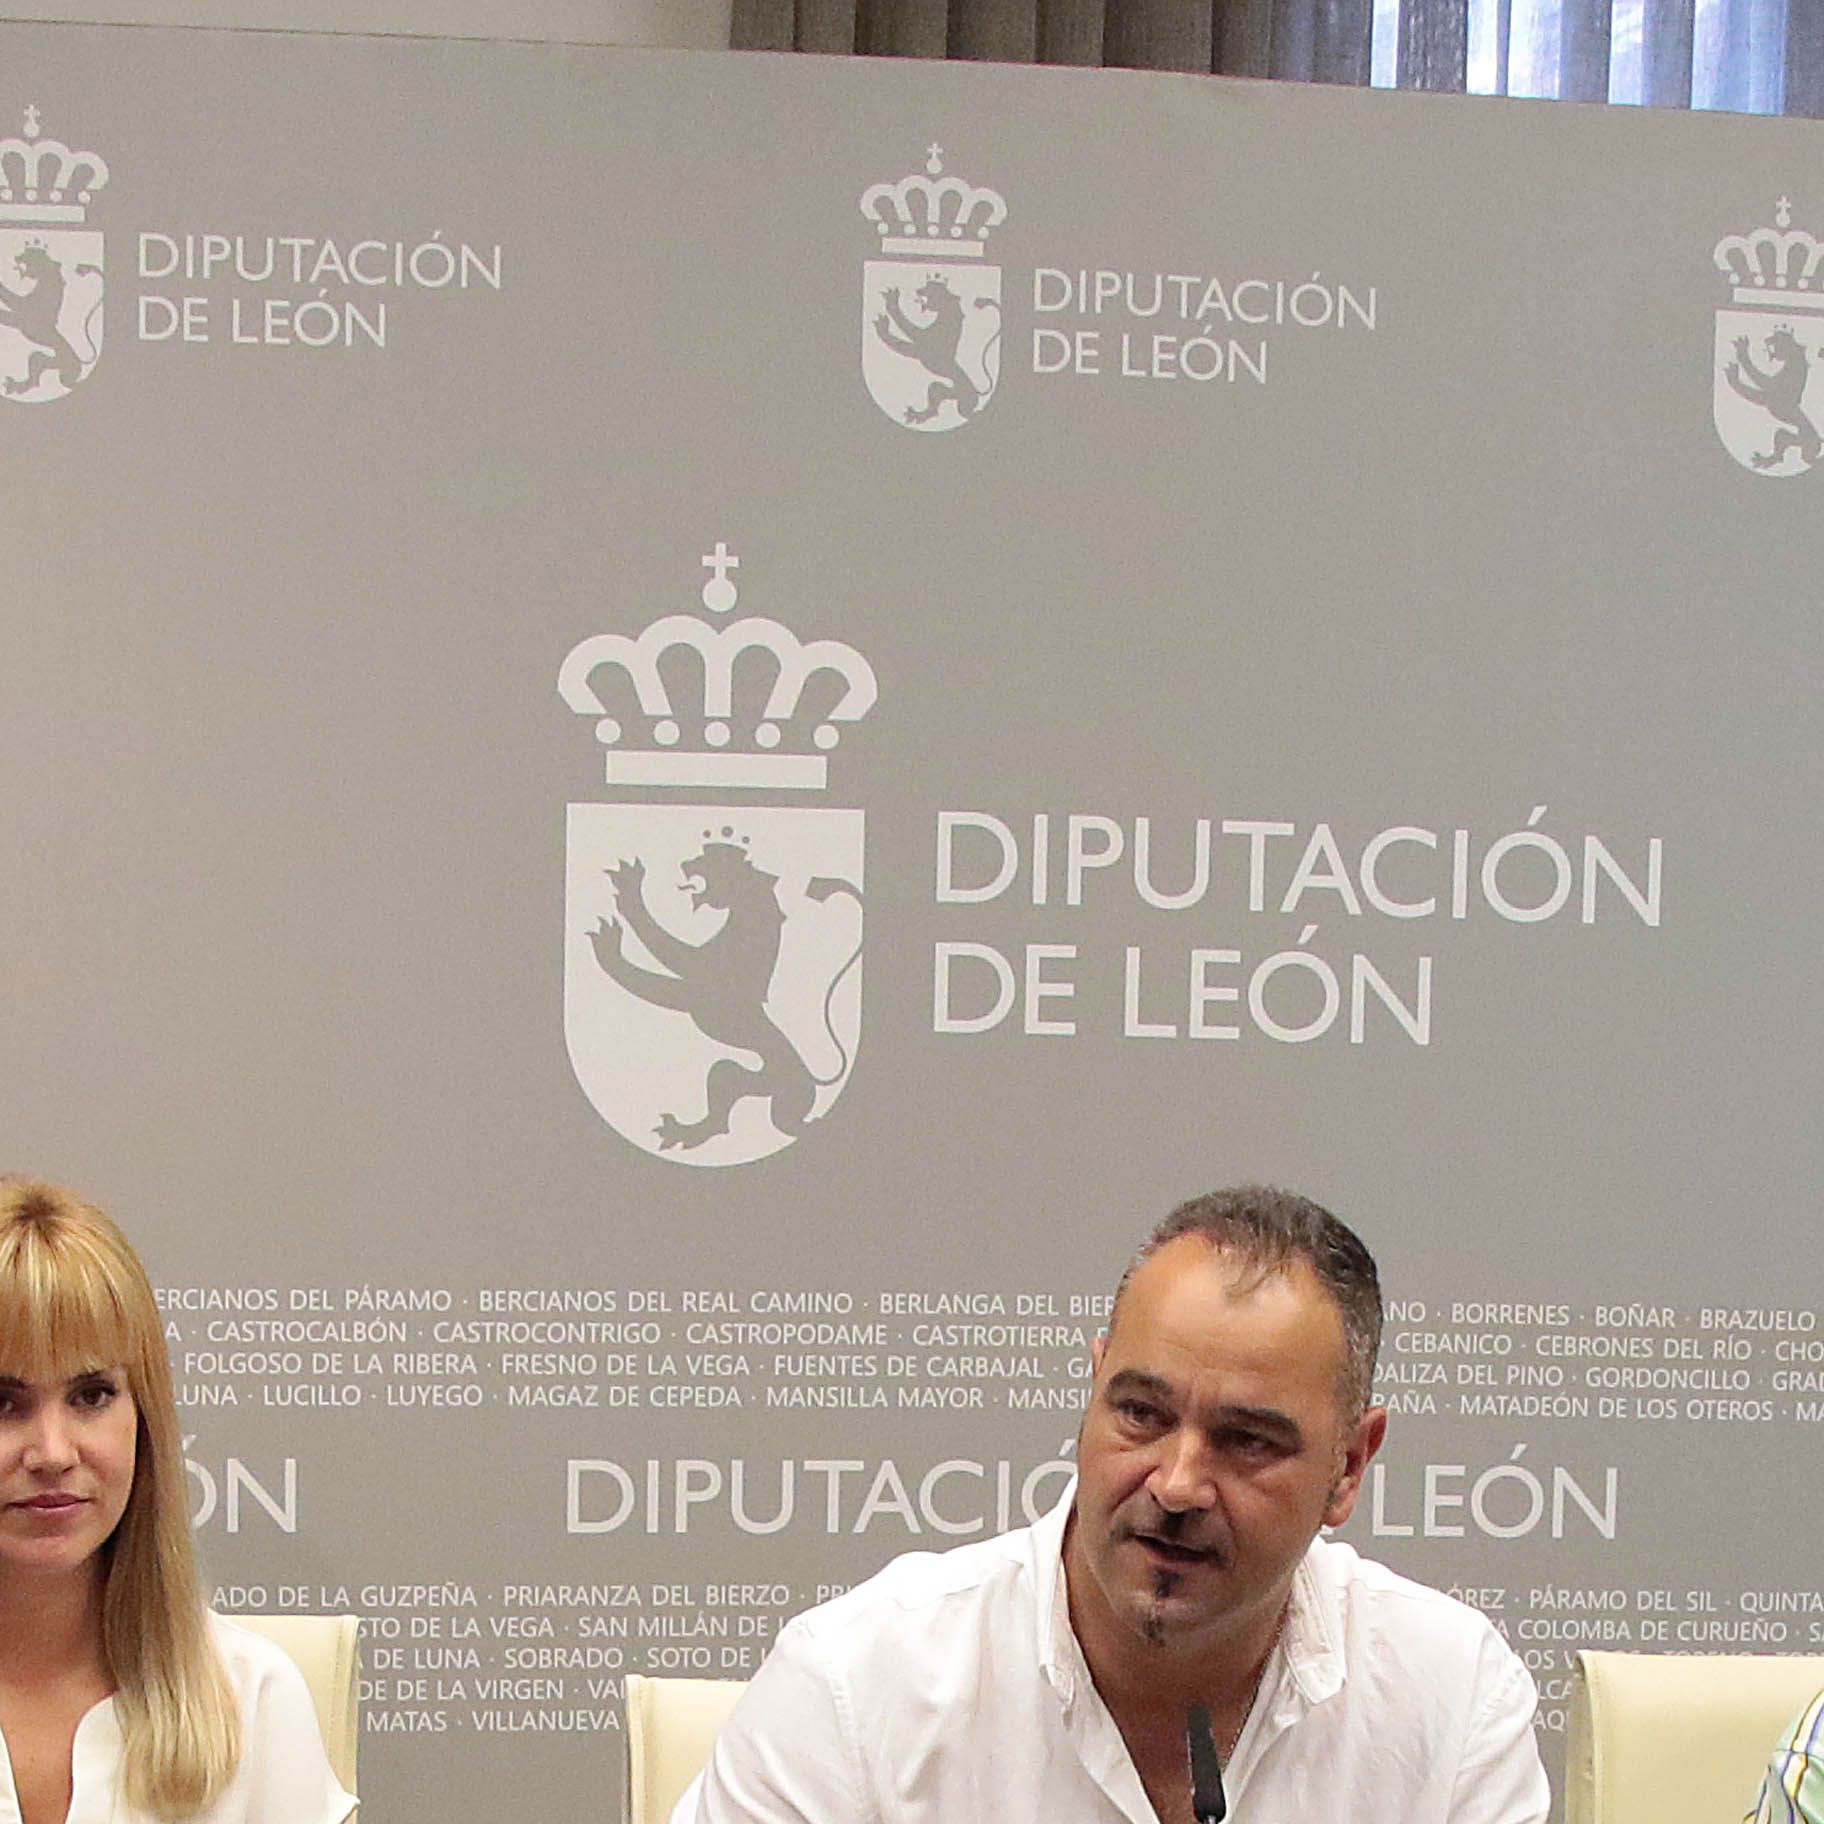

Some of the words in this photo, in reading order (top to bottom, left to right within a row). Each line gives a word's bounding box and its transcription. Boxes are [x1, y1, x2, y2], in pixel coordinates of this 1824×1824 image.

[139, 231, 501, 289] DIPUTACIÓN
[1035, 269, 1376, 329] DIPUTACIÓN
[139, 296, 208, 341] DE
[233, 288, 385, 347] LEÓN
[1033, 329, 1099, 374] DE
[1122, 325, 1266, 383] LEÓN
[937, 806, 1662, 926] DIPUTACIÓN
[934, 942, 1076, 1035] DE
[1125, 925, 1431, 1045] LEÓN
[479, 1290, 617, 1313] BERCIANOS
[628, 1290, 672, 1313] DEL
[682, 1291, 741, 1313] REAL
[750, 1291, 853, 1314] CAMINO
[879, 1292, 1006, 1316] BERLANGA
[1451, 1302, 1570, 1326] BORRENES
[1595, 1302, 1676, 1328] BOÑAR
[1700, 1308, 1816, 1332] BRAZUELO
[207, 1316, 407, 1343] CASTROCALBÓN
[433, 1321, 661, 1344] CASTROCONTRIGO
[686, 1322, 887, 1346] CASTROPODAME
[912, 1324, 1087, 1347] CASTROTIERRA
[1394, 1331, 1512, 1356] CEBANICO
[502, 1353, 597, 1376] FRESNO
[606, 1353, 638, 1376] DE
[647, 1354, 678, 1376] LA
[685, 1354, 750, 1376] VEGA
[1585, 1366, 1751, 1391] GORDONCILLO
[263, 1383, 362, 1407] LUCILLO
[387, 1384, 484, 1407] LUYEGO
[766, 1386, 889, 1408] MANSILLA
[897, 1386, 984, 1409] MAYOR
[567, 1440, 1077, 1536] DIPUTACIÓ
[1372, 1444, 1617, 1540] LEÓN
[503, 1585, 642, 1607] PRIARANZA
[652, 1584, 696, 1607] DEL
[705, 1584, 790, 1606] BIERZO
[1529, 1583, 1628, 1611] PÁRAMO
[1636, 1589, 1678, 1612] DEL
[1686, 1590, 1718, 1612] SIL
[504, 1647, 623, 1670] SOBRADO
[472, 1710, 620, 1735] VILLANUEVA
